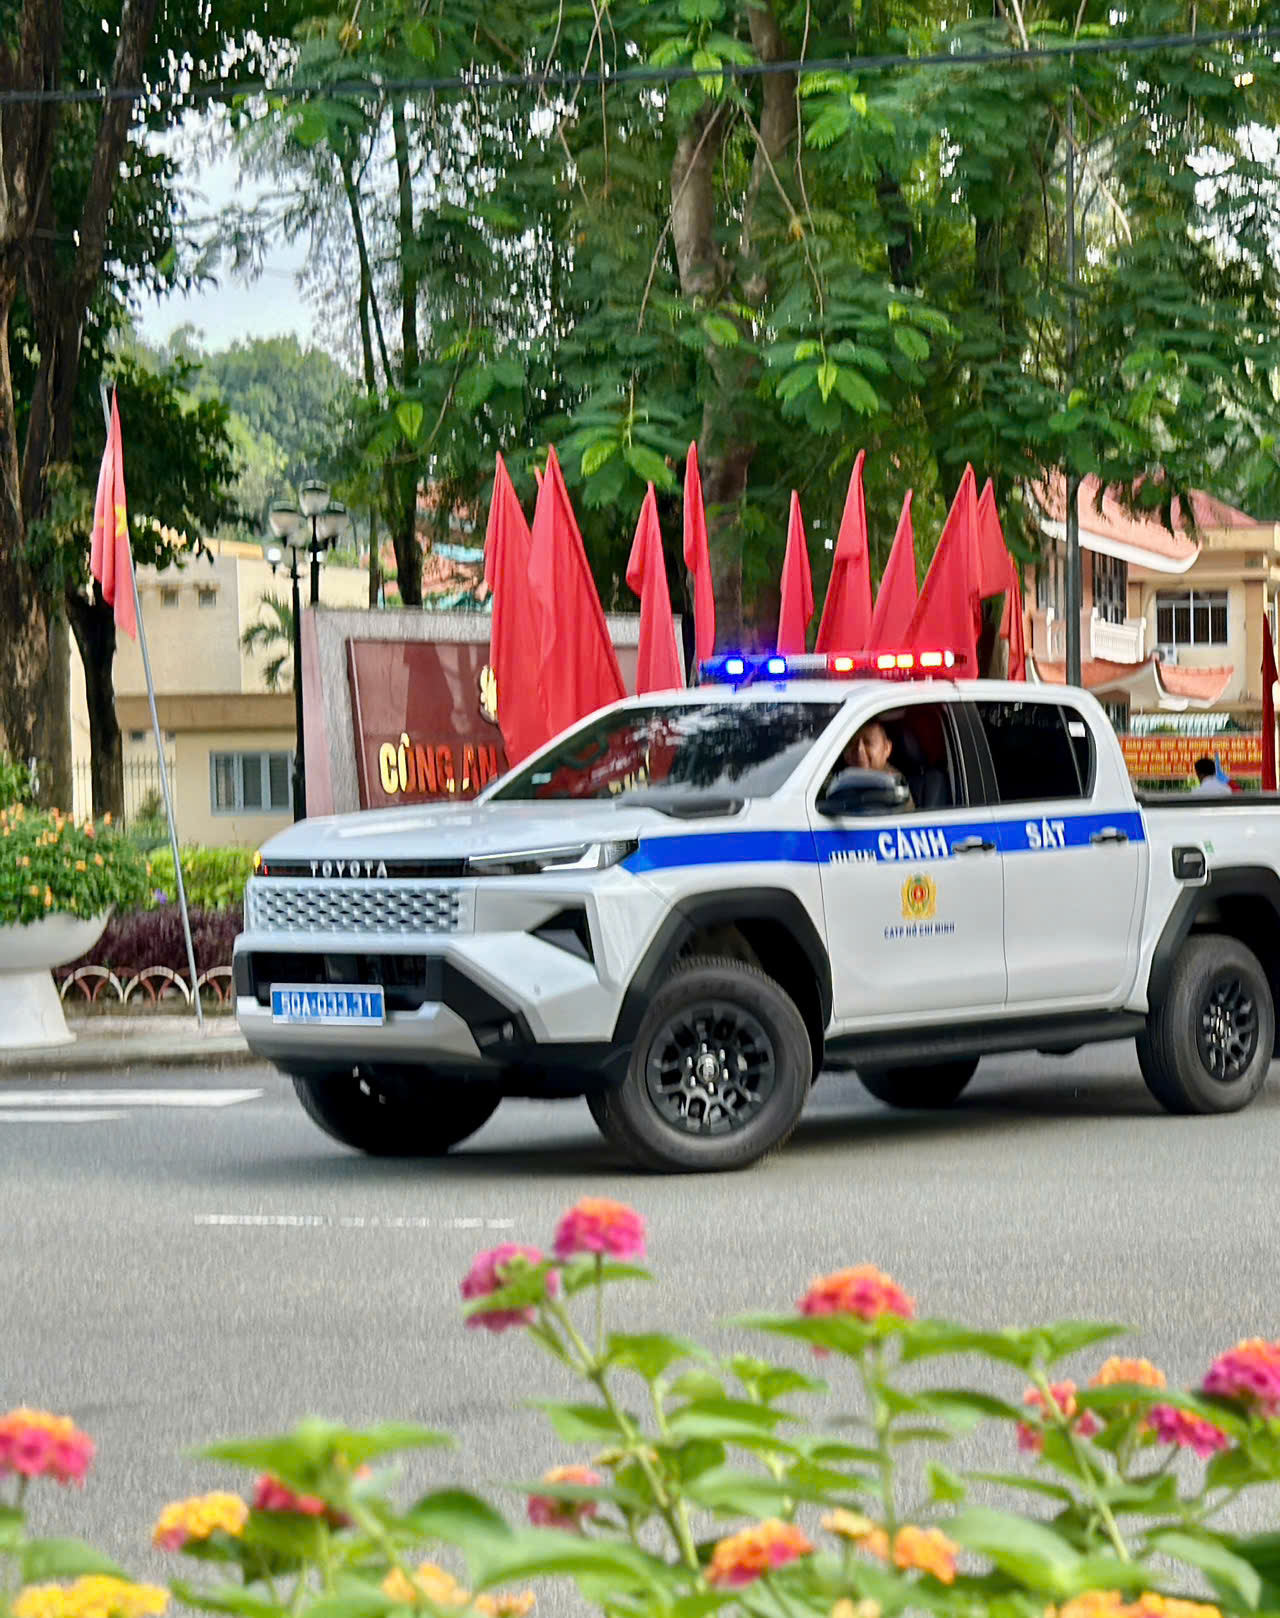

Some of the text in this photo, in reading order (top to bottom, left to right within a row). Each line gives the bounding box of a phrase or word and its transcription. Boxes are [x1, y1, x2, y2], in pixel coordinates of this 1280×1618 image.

[379, 732, 499, 794] CÔNG AN
[878, 826, 949, 861] CẢNH
[1025, 816, 1067, 849] SÁT
[310, 860, 388, 878] TOYOTA
